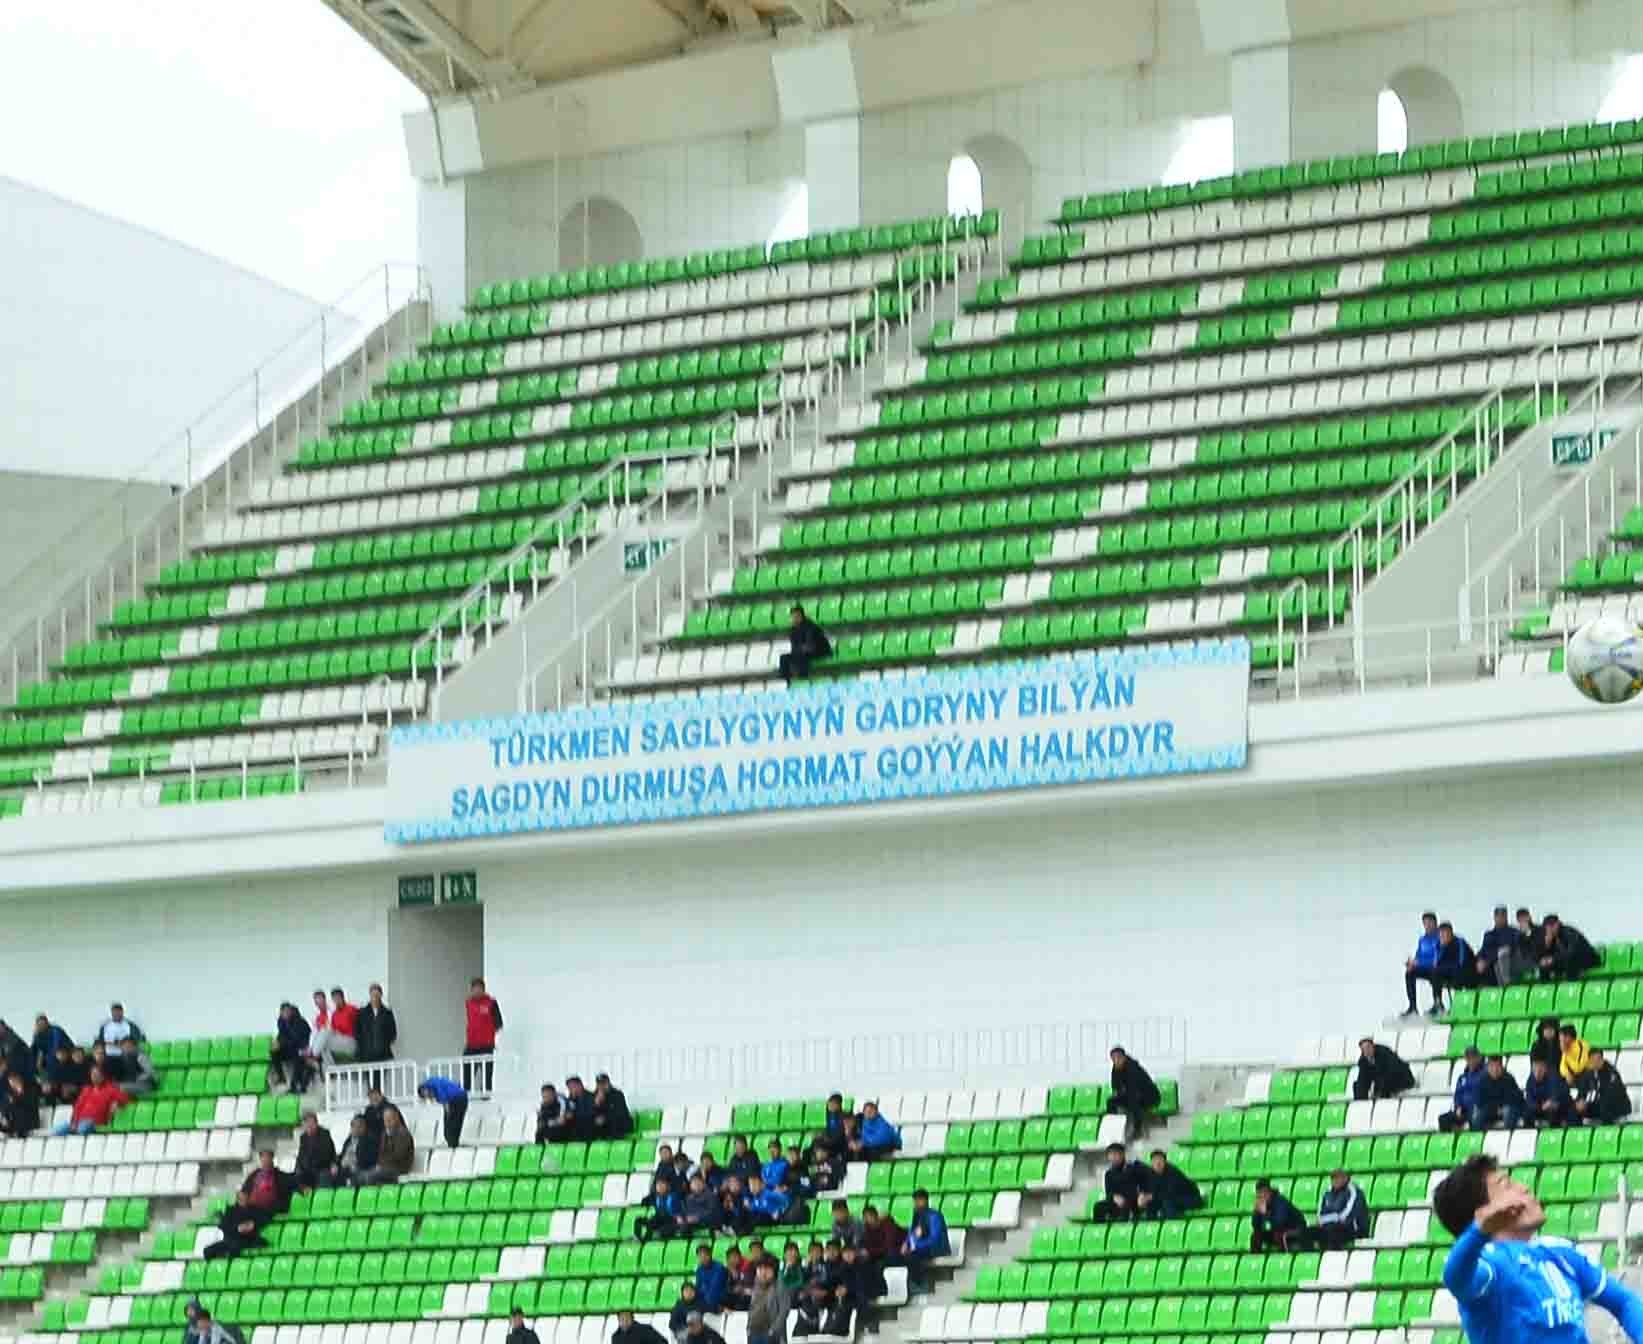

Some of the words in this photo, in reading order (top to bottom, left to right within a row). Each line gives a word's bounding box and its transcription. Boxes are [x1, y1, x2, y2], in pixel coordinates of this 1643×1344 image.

[451, 776, 571, 819] SAGDYN
[738, 750, 867, 794] HORMAT
[1020, 720, 1175, 767] HALKDYR
[489, 725, 630, 768] TÜRKMEN
[855, 687, 1008, 734] GADRYNY
